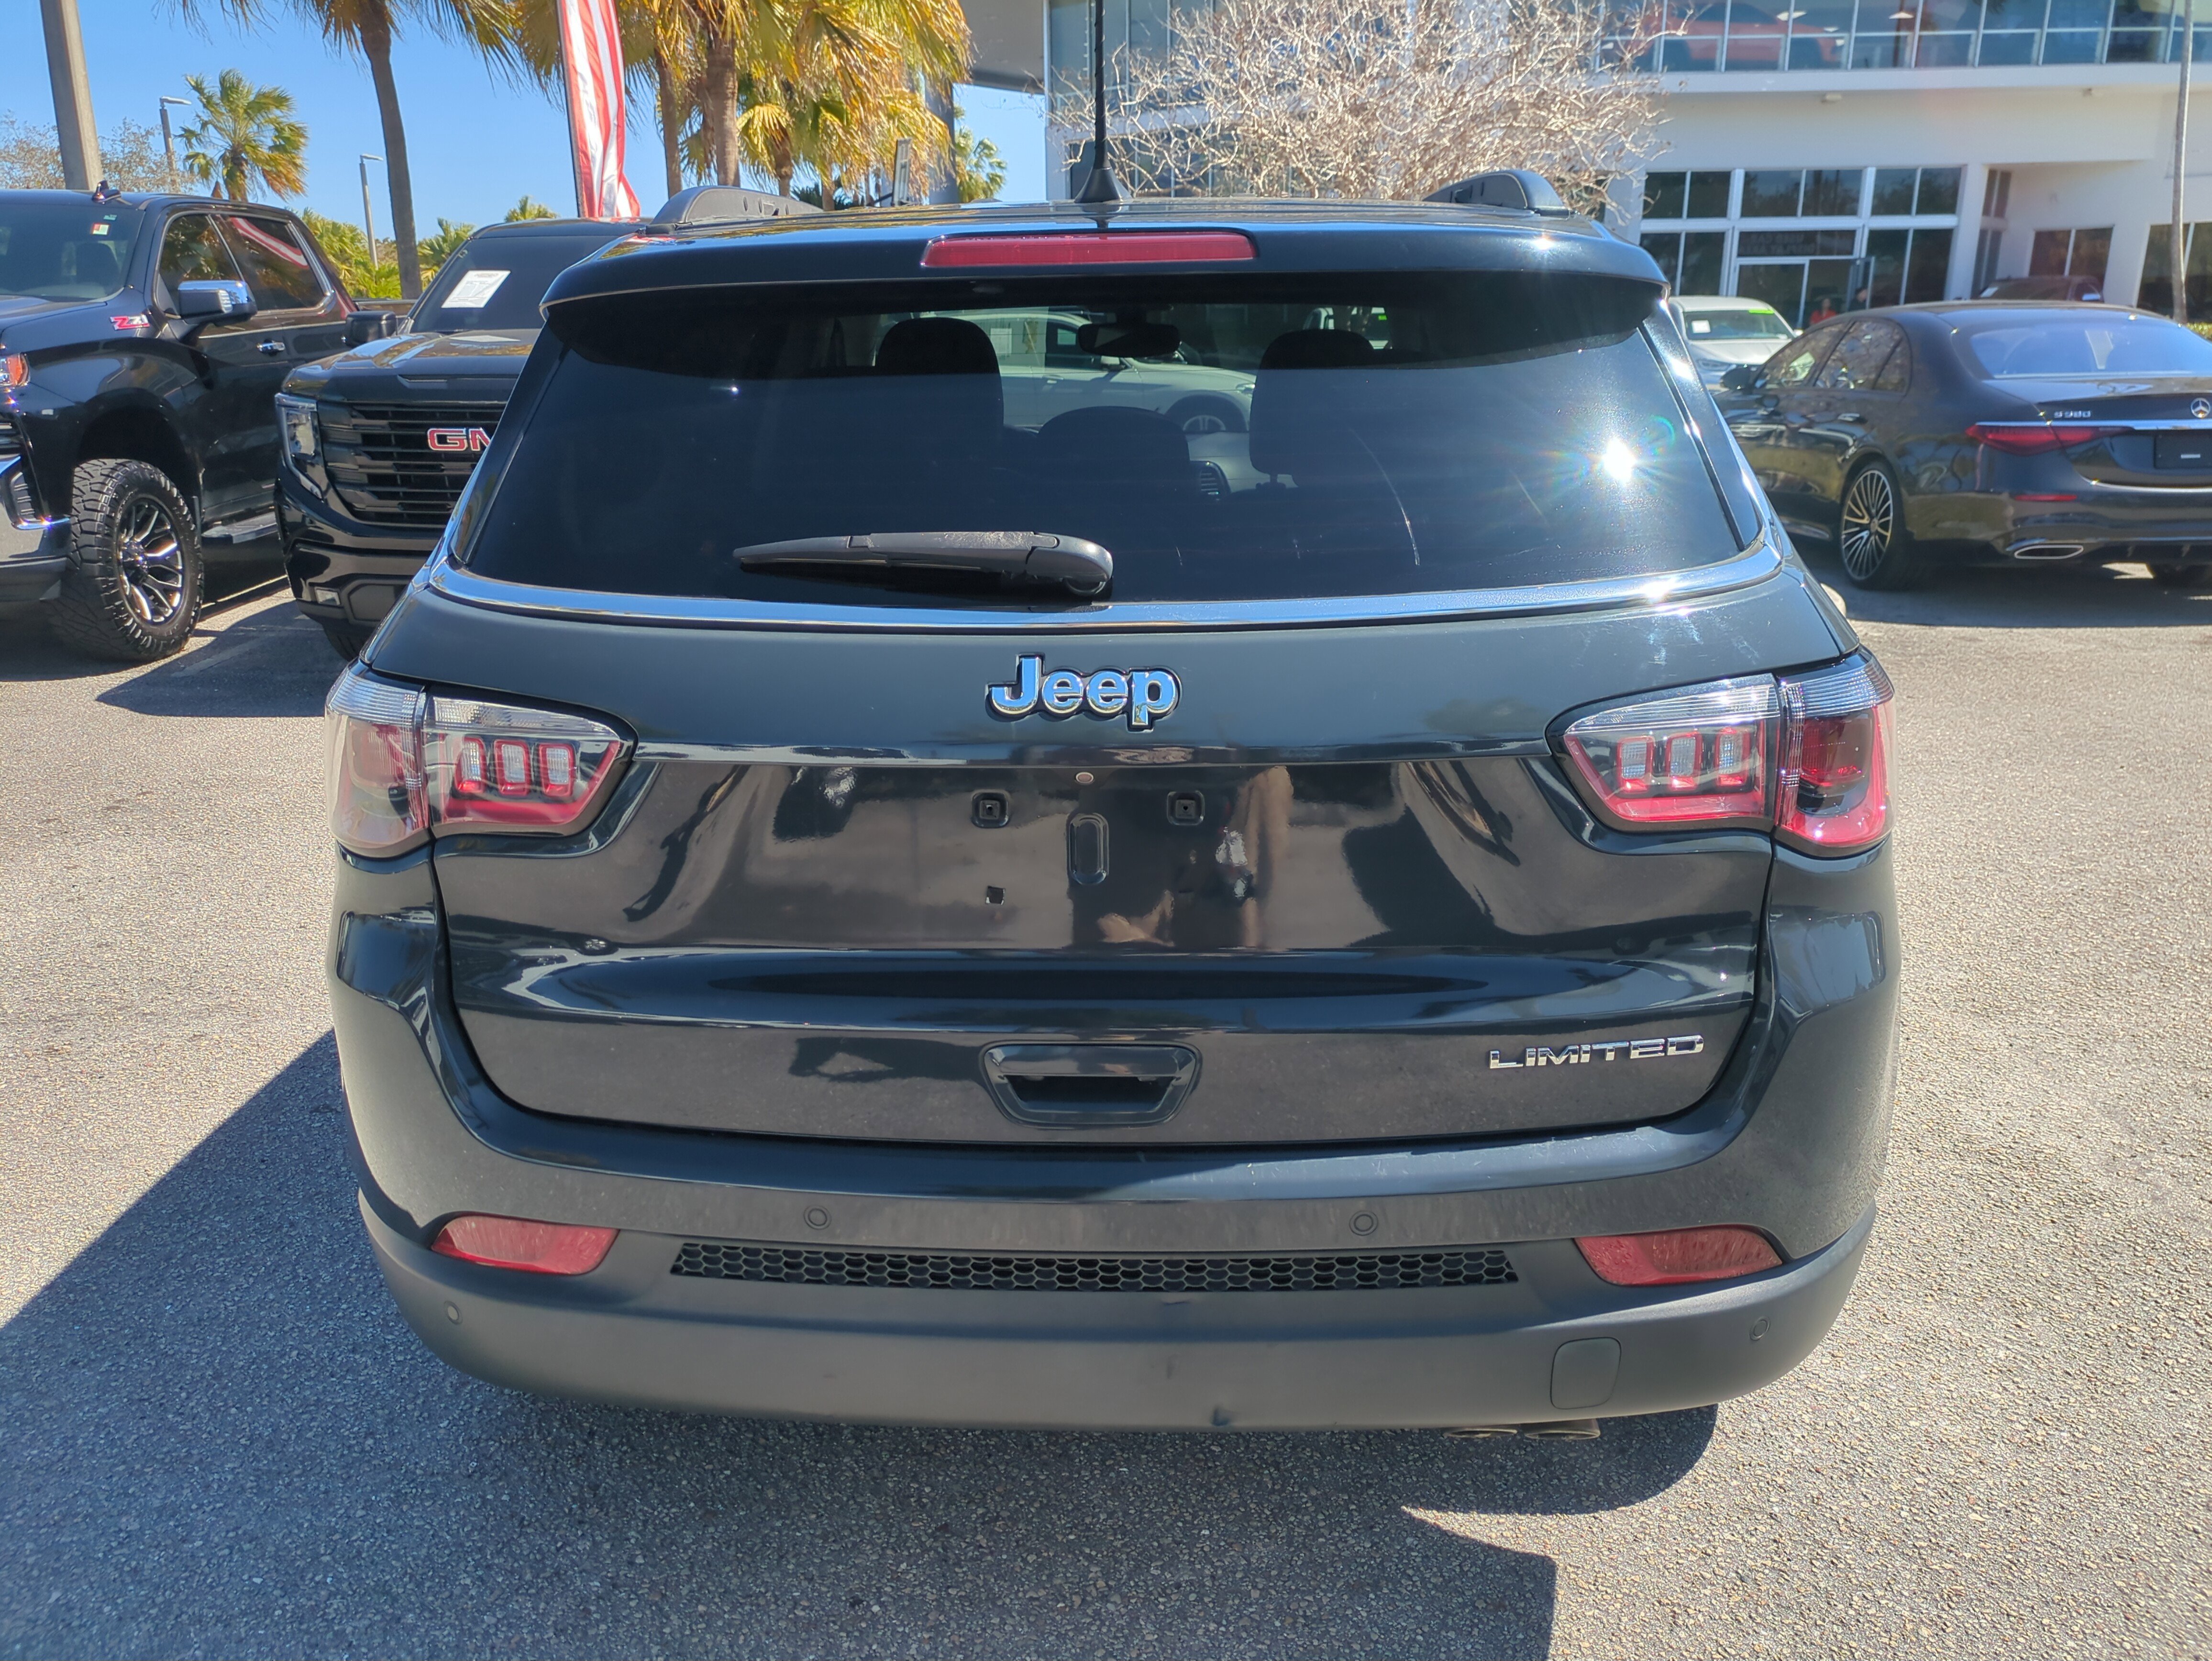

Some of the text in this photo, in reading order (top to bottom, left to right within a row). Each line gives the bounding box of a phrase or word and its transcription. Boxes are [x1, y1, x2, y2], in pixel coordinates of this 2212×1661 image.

[110, 314, 150, 331] Z71
[427, 427, 491, 451] GM
[989, 655, 1180, 728] Jeep
[1489, 1034, 1704, 1069] LIMITED
